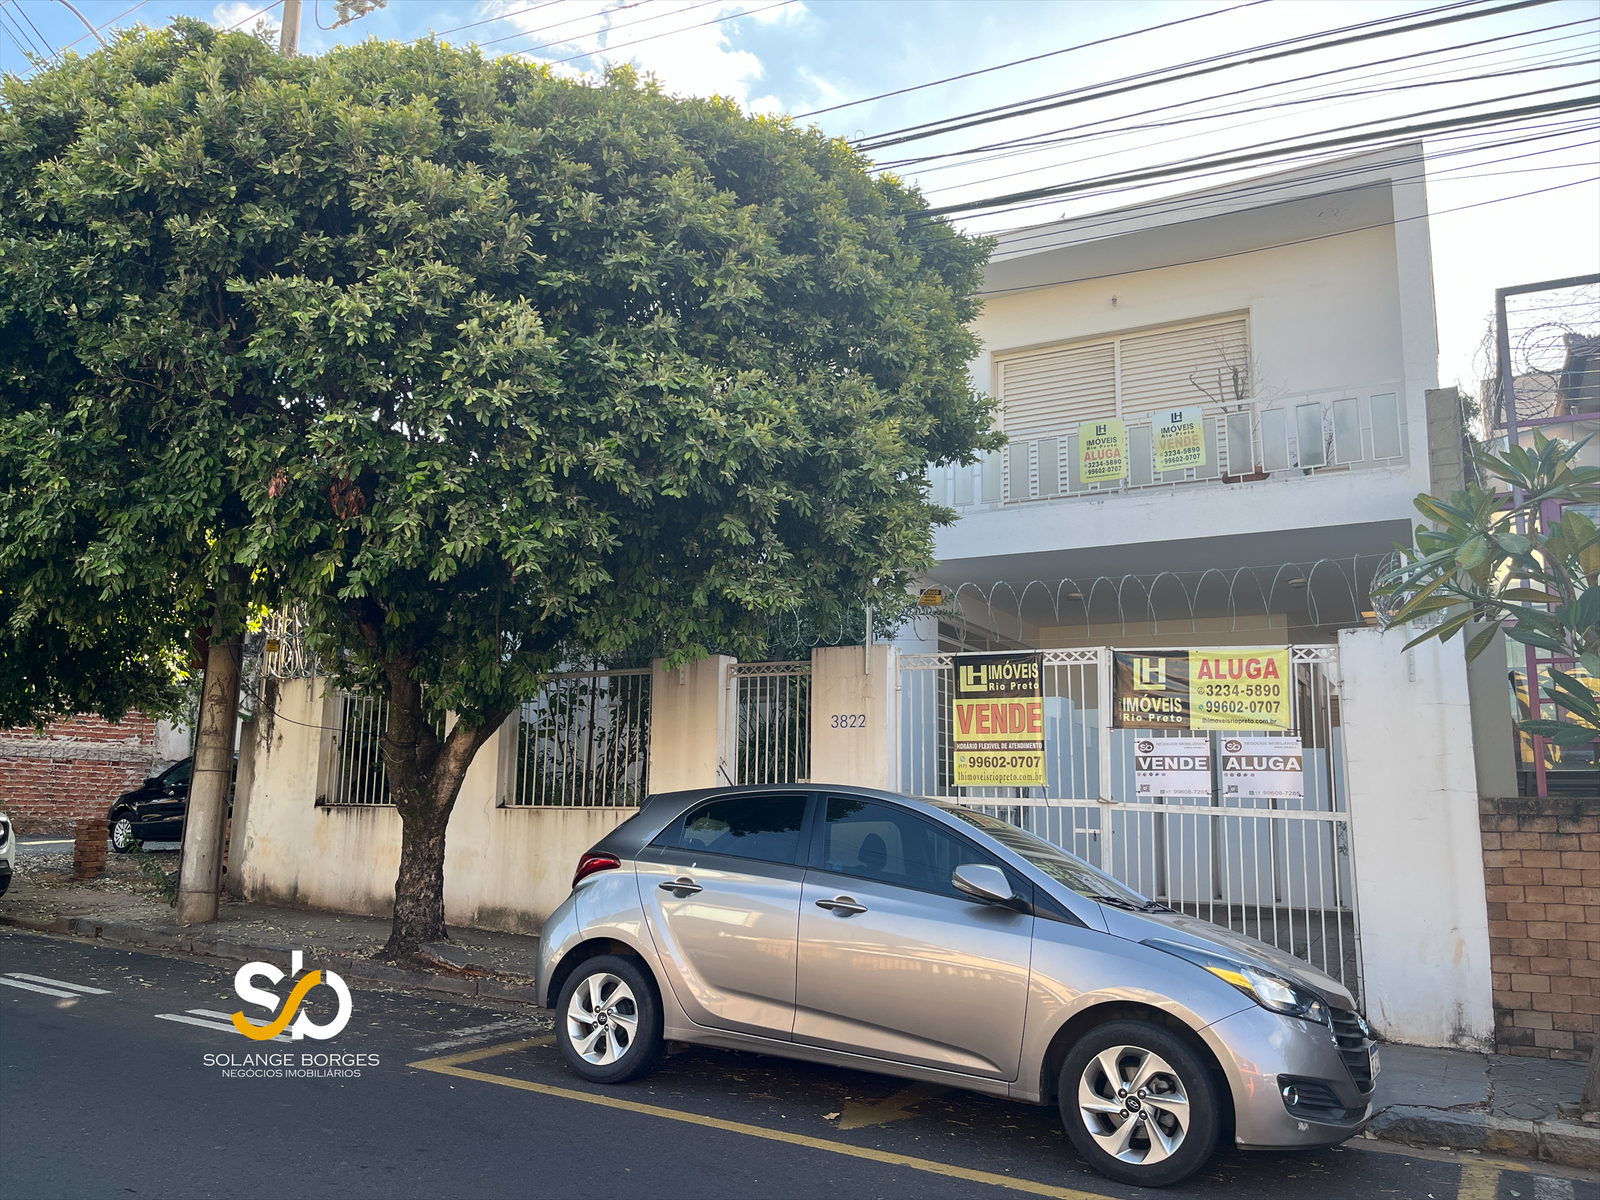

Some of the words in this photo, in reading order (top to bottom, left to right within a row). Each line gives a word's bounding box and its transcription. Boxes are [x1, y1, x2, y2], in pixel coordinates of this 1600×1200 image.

[1160, 423, 1194, 434] IMÓVEIS
[1086, 436, 1118, 447] IMÓVEIS
[1159, 434, 1200, 451] VENDE
[1084, 447, 1121, 462] ALUGA
[1163, 446, 1201, 457] 3234-5890
[1087, 458, 1122, 469] 3234-5890
[1163, 453, 1201, 464] 99602-0707
[1087, 465, 1122, 475] 99602-0707
[988, 661, 1039, 680] IMÓVEIS
[1133, 658, 1166, 690] LH
[1197, 658, 1280, 680] ALUGA
[960, 665, 987, 692] LH
[989, 682, 1006, 691] Rio
[1010, 681, 1039, 690] Preto
[1206, 684, 1280, 697] 3234-5890
[1122, 694, 1182, 713] IMÓVEIS
[1206, 700, 1280, 713] 99602-0707
[831, 714, 866, 728] 3822
[956, 703, 1042, 734] VENDE
[1123, 714, 1142, 722] Rio
[1149, 714, 1183, 722] Preto
[957, 742, 978, 750] HORÁRIO
[968, 756, 1042, 768] 99602-0707
[1138, 757, 1208, 770] VENDE
[1225, 757, 1302, 770] ALUGA
[958, 772, 1043, 783] lhimoveisriopreto.com.br
